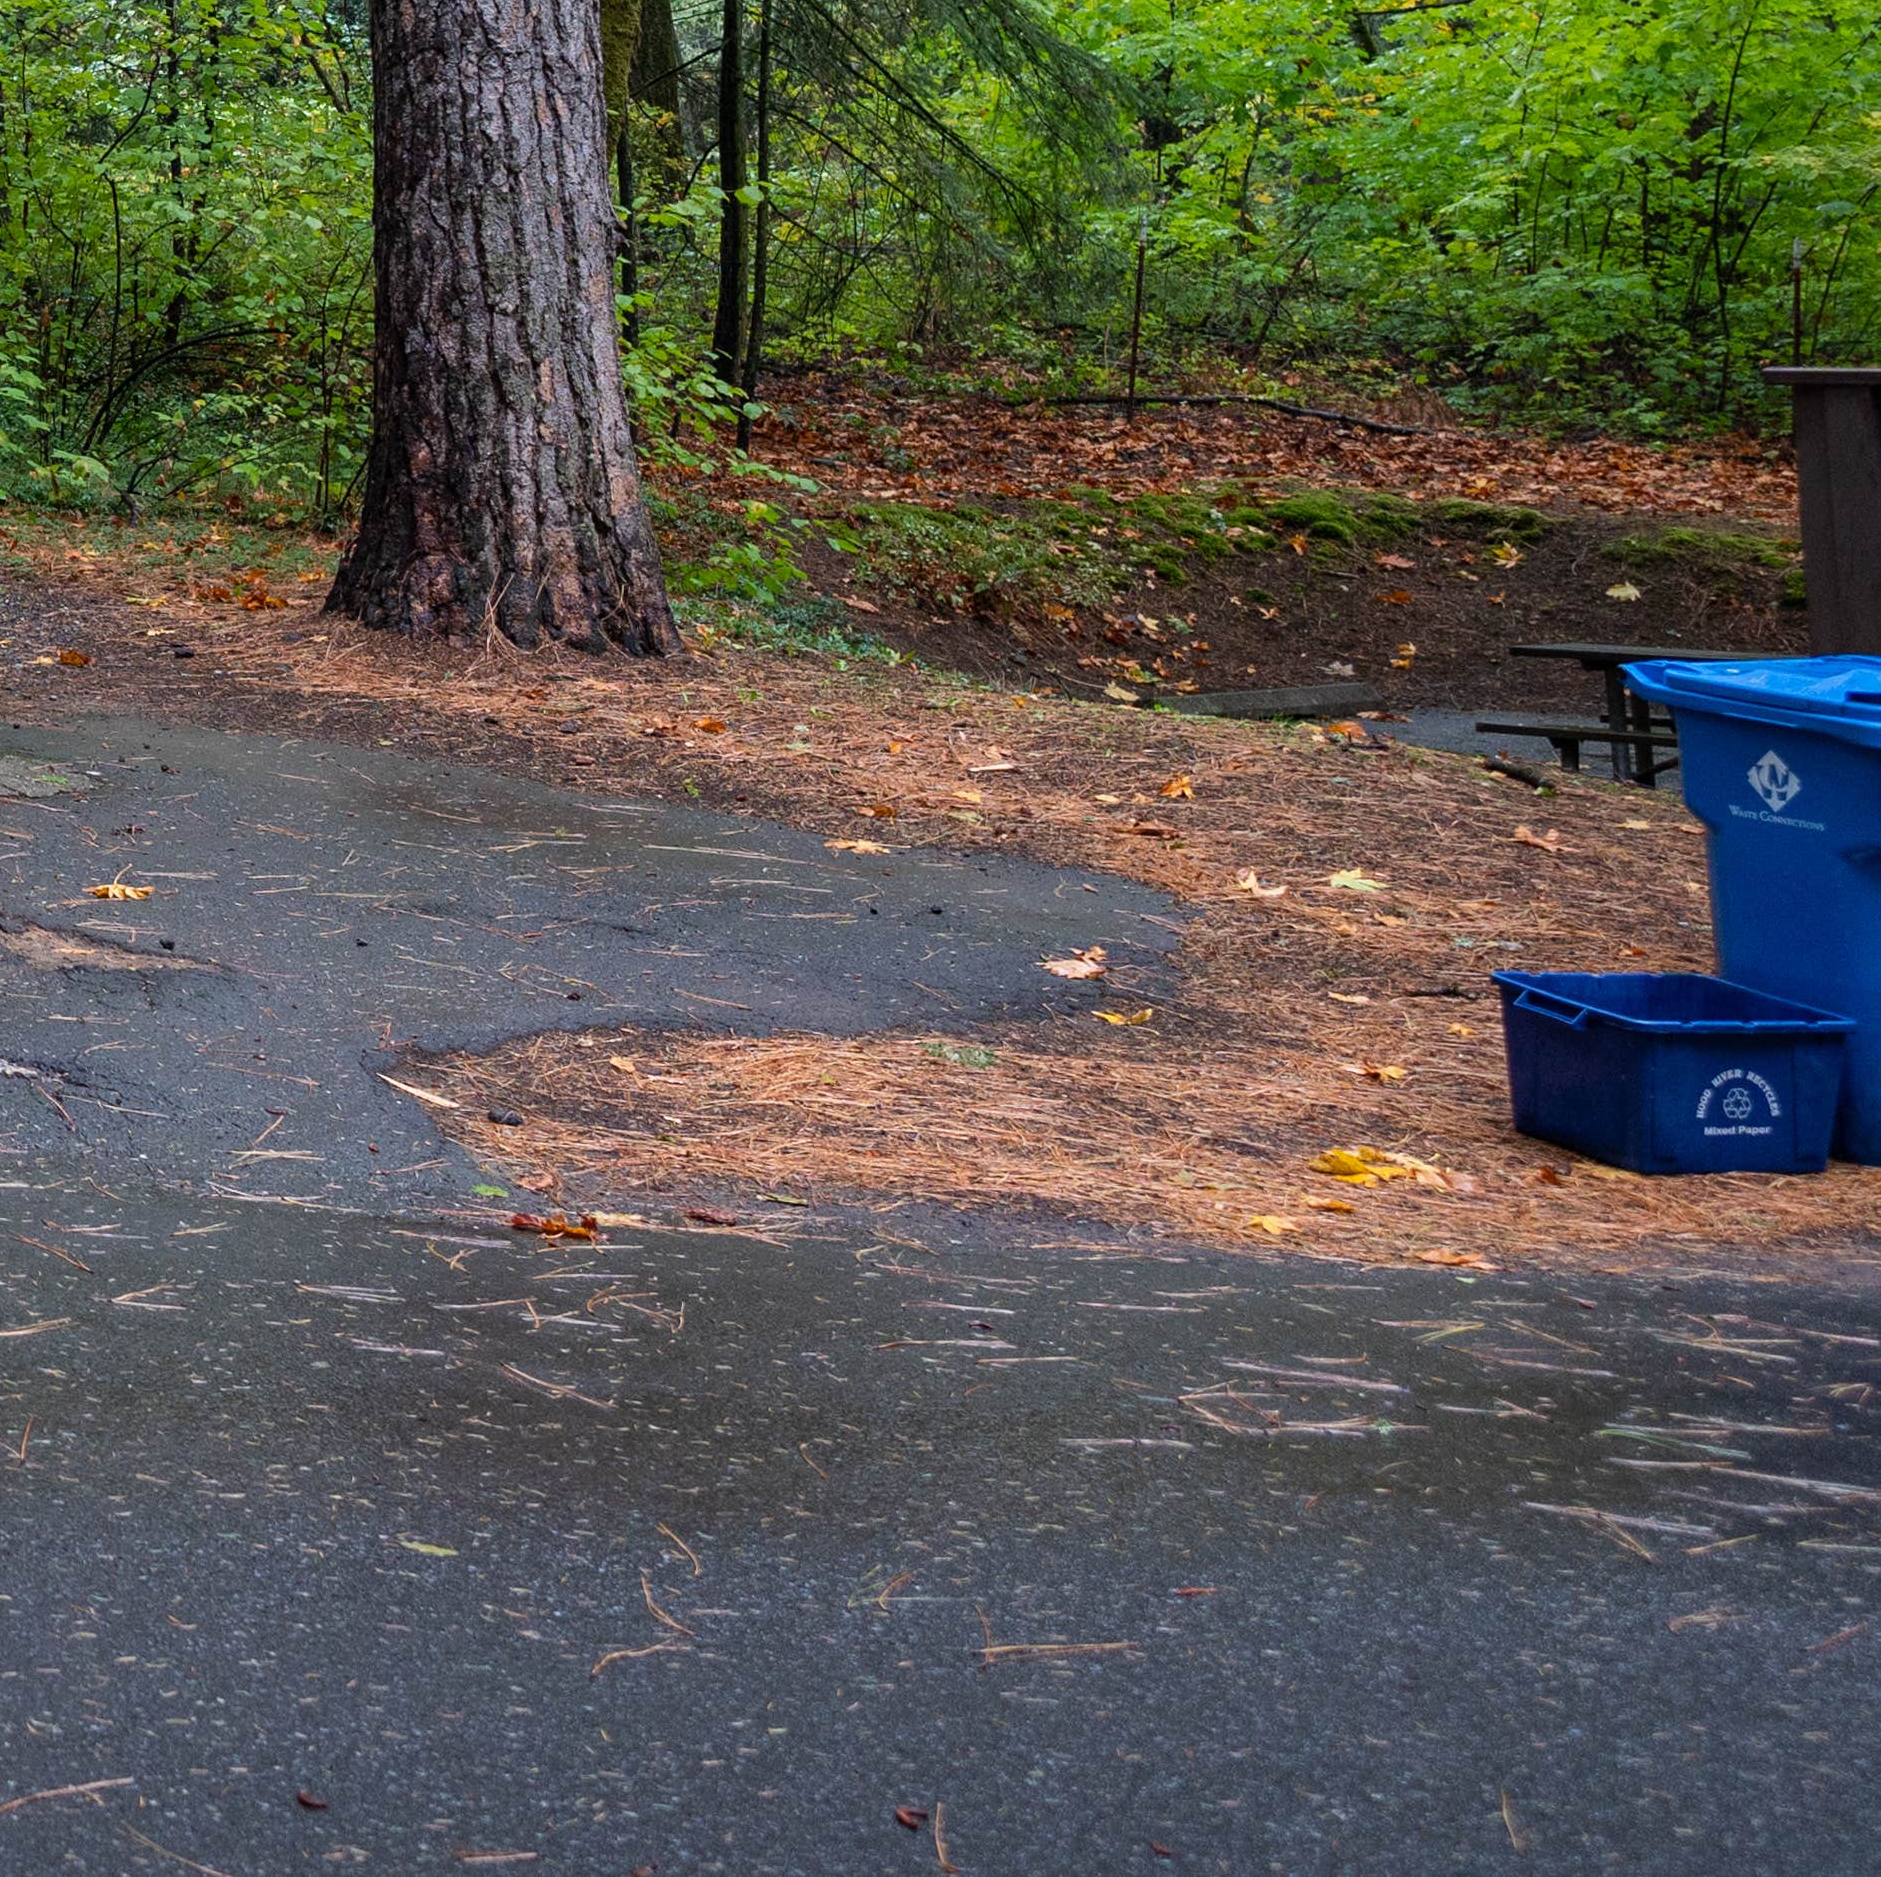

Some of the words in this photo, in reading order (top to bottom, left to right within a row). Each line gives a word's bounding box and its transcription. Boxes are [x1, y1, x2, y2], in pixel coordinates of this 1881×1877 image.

[1696, 1088, 1712, 1119] HOOD
[1711, 1068, 1743, 1088] RIVER
[1746, 1070, 1782, 1117] RECYCLES
[1704, 1125, 1736, 1136] Mixed
[1738, 1125, 1772, 1136] Paper
